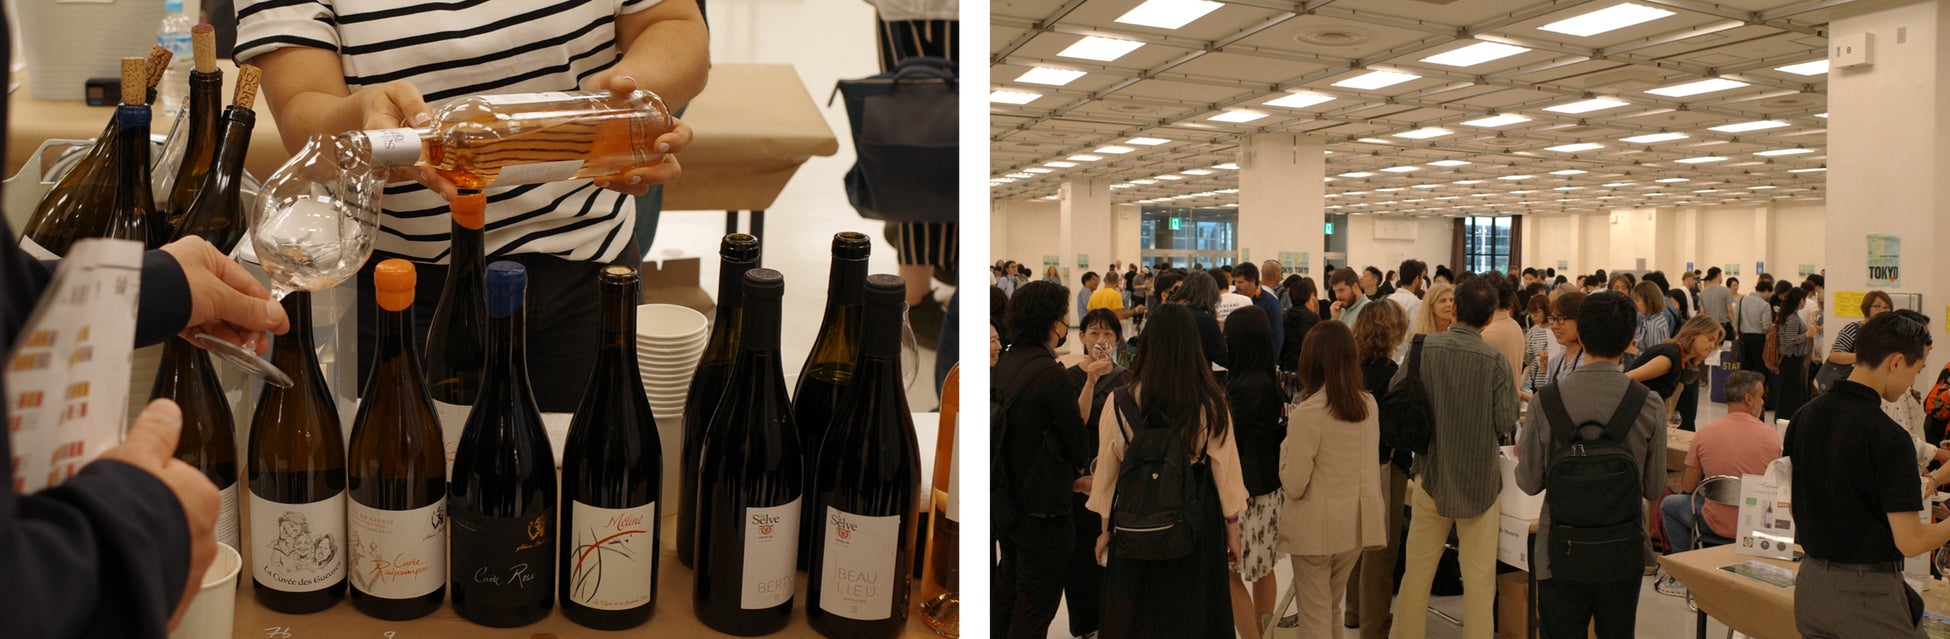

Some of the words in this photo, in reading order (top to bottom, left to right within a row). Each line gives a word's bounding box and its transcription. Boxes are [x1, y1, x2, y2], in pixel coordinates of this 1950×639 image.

[1868, 266, 1899, 280] TOKYO
[263, 565, 272, 576] La
[272, 573, 297, 586] Cuvée
[298, 578, 313, 586] des
[838, 567, 878, 584] BEAU
[837, 580, 876, 598] LIEU
